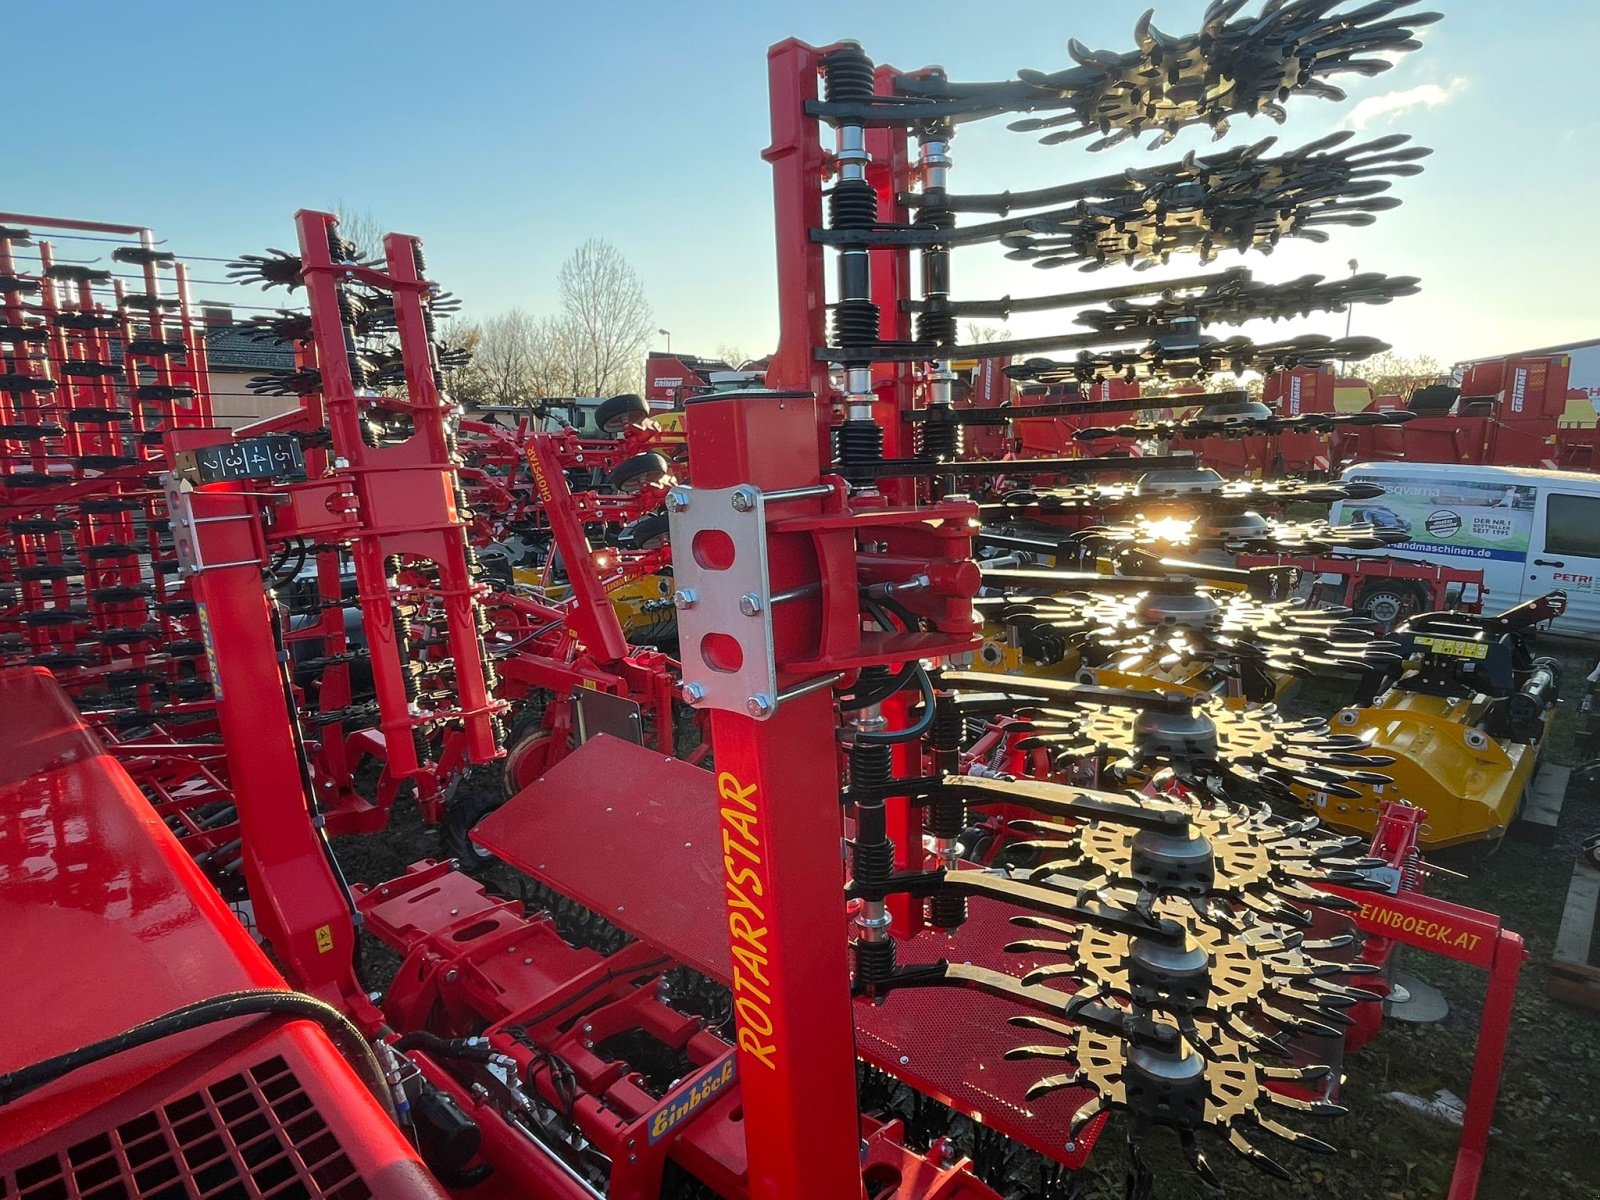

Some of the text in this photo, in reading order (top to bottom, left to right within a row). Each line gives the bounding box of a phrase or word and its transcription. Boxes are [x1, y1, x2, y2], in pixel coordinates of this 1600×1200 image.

[1291, 376, 1301, 415] GRIMME
[1511, 368, 1527, 413] GRIMME
[204, 460, 218, 469] 2
[226, 457, 242, 466] 3
[251, 454, 267, 463] 4
[275, 452, 290, 461] 5
[527, 446, 552, 502] CHOPSTAR
[1473, 523, 1511, 531] BESTSELLER
[1553, 572, 1593, 583] PETRI
[718, 771, 777, 1071] ROTARYSTAR
[652, 1059, 733, 1137] Einböck
